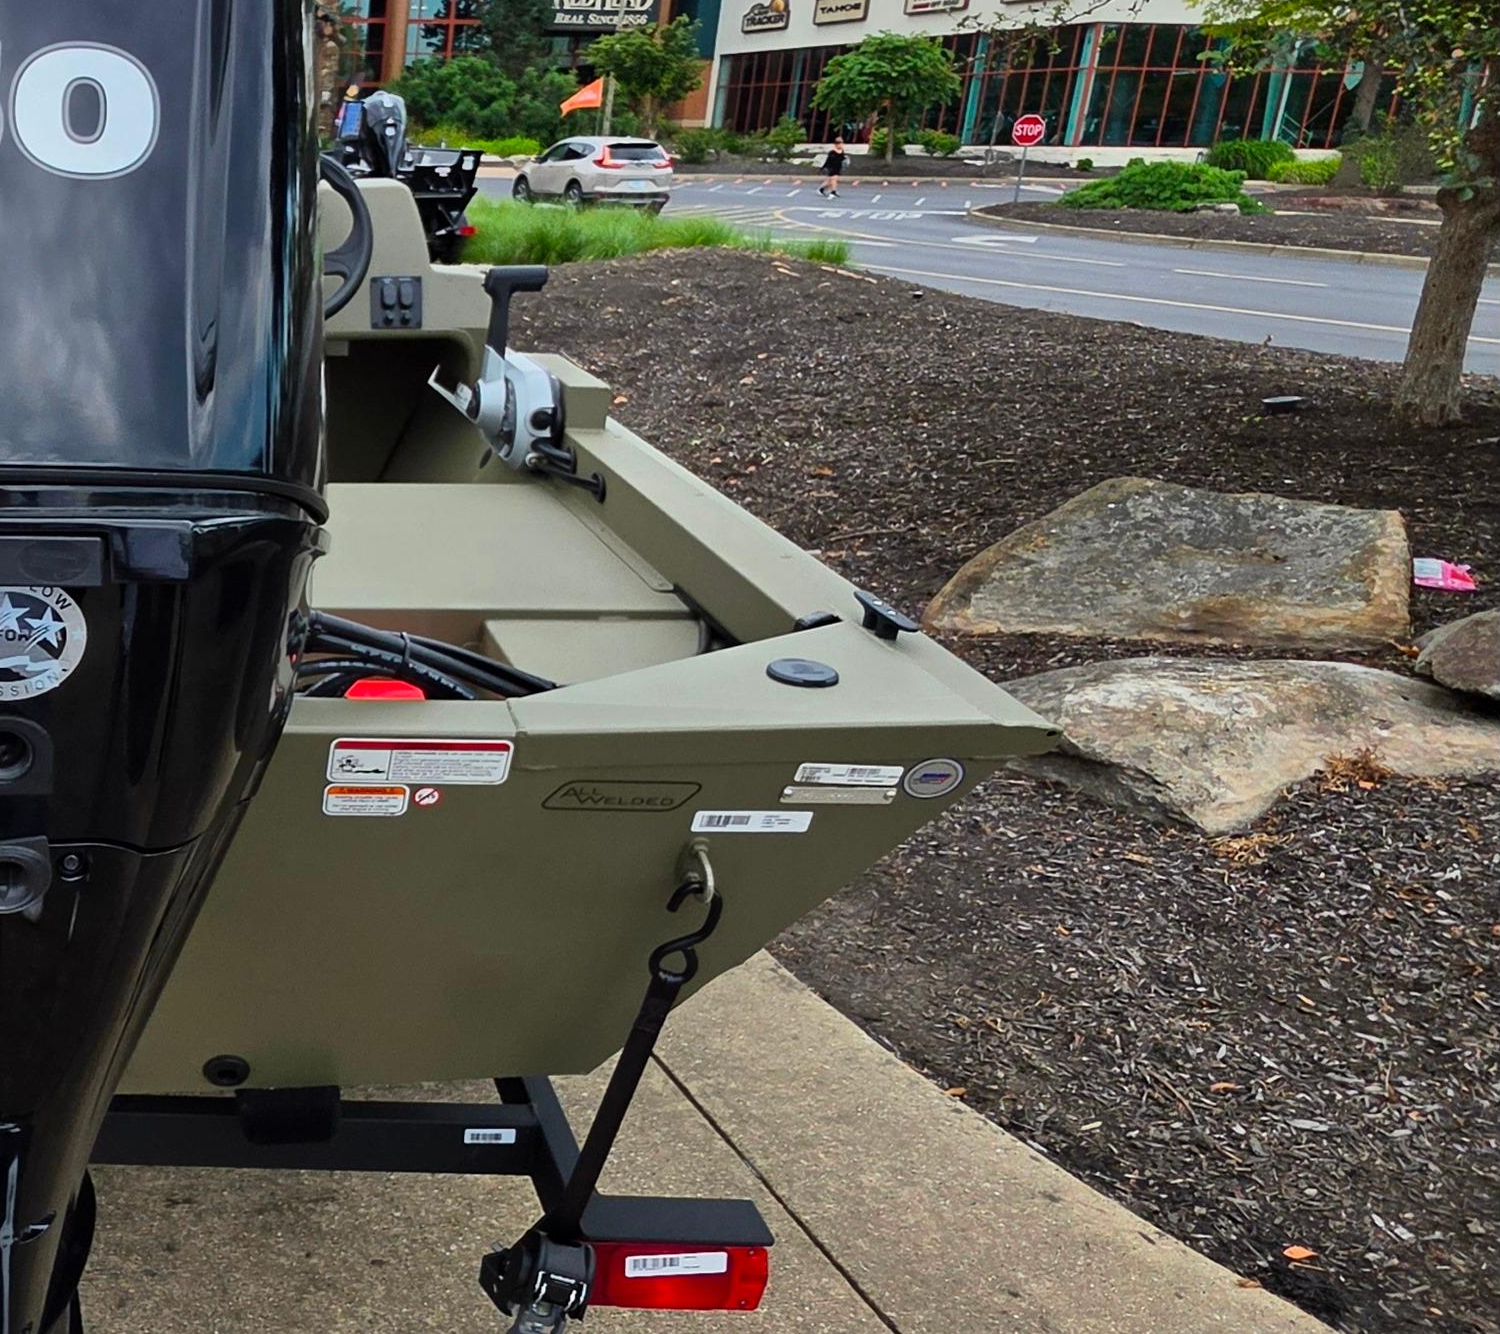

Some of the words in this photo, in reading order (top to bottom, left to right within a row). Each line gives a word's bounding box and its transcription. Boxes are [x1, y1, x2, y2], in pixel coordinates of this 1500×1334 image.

[820, 2, 862, 14] TAHOE
[554, 13, 585, 24] REAL
[1015, 123, 1044, 136] STOP
